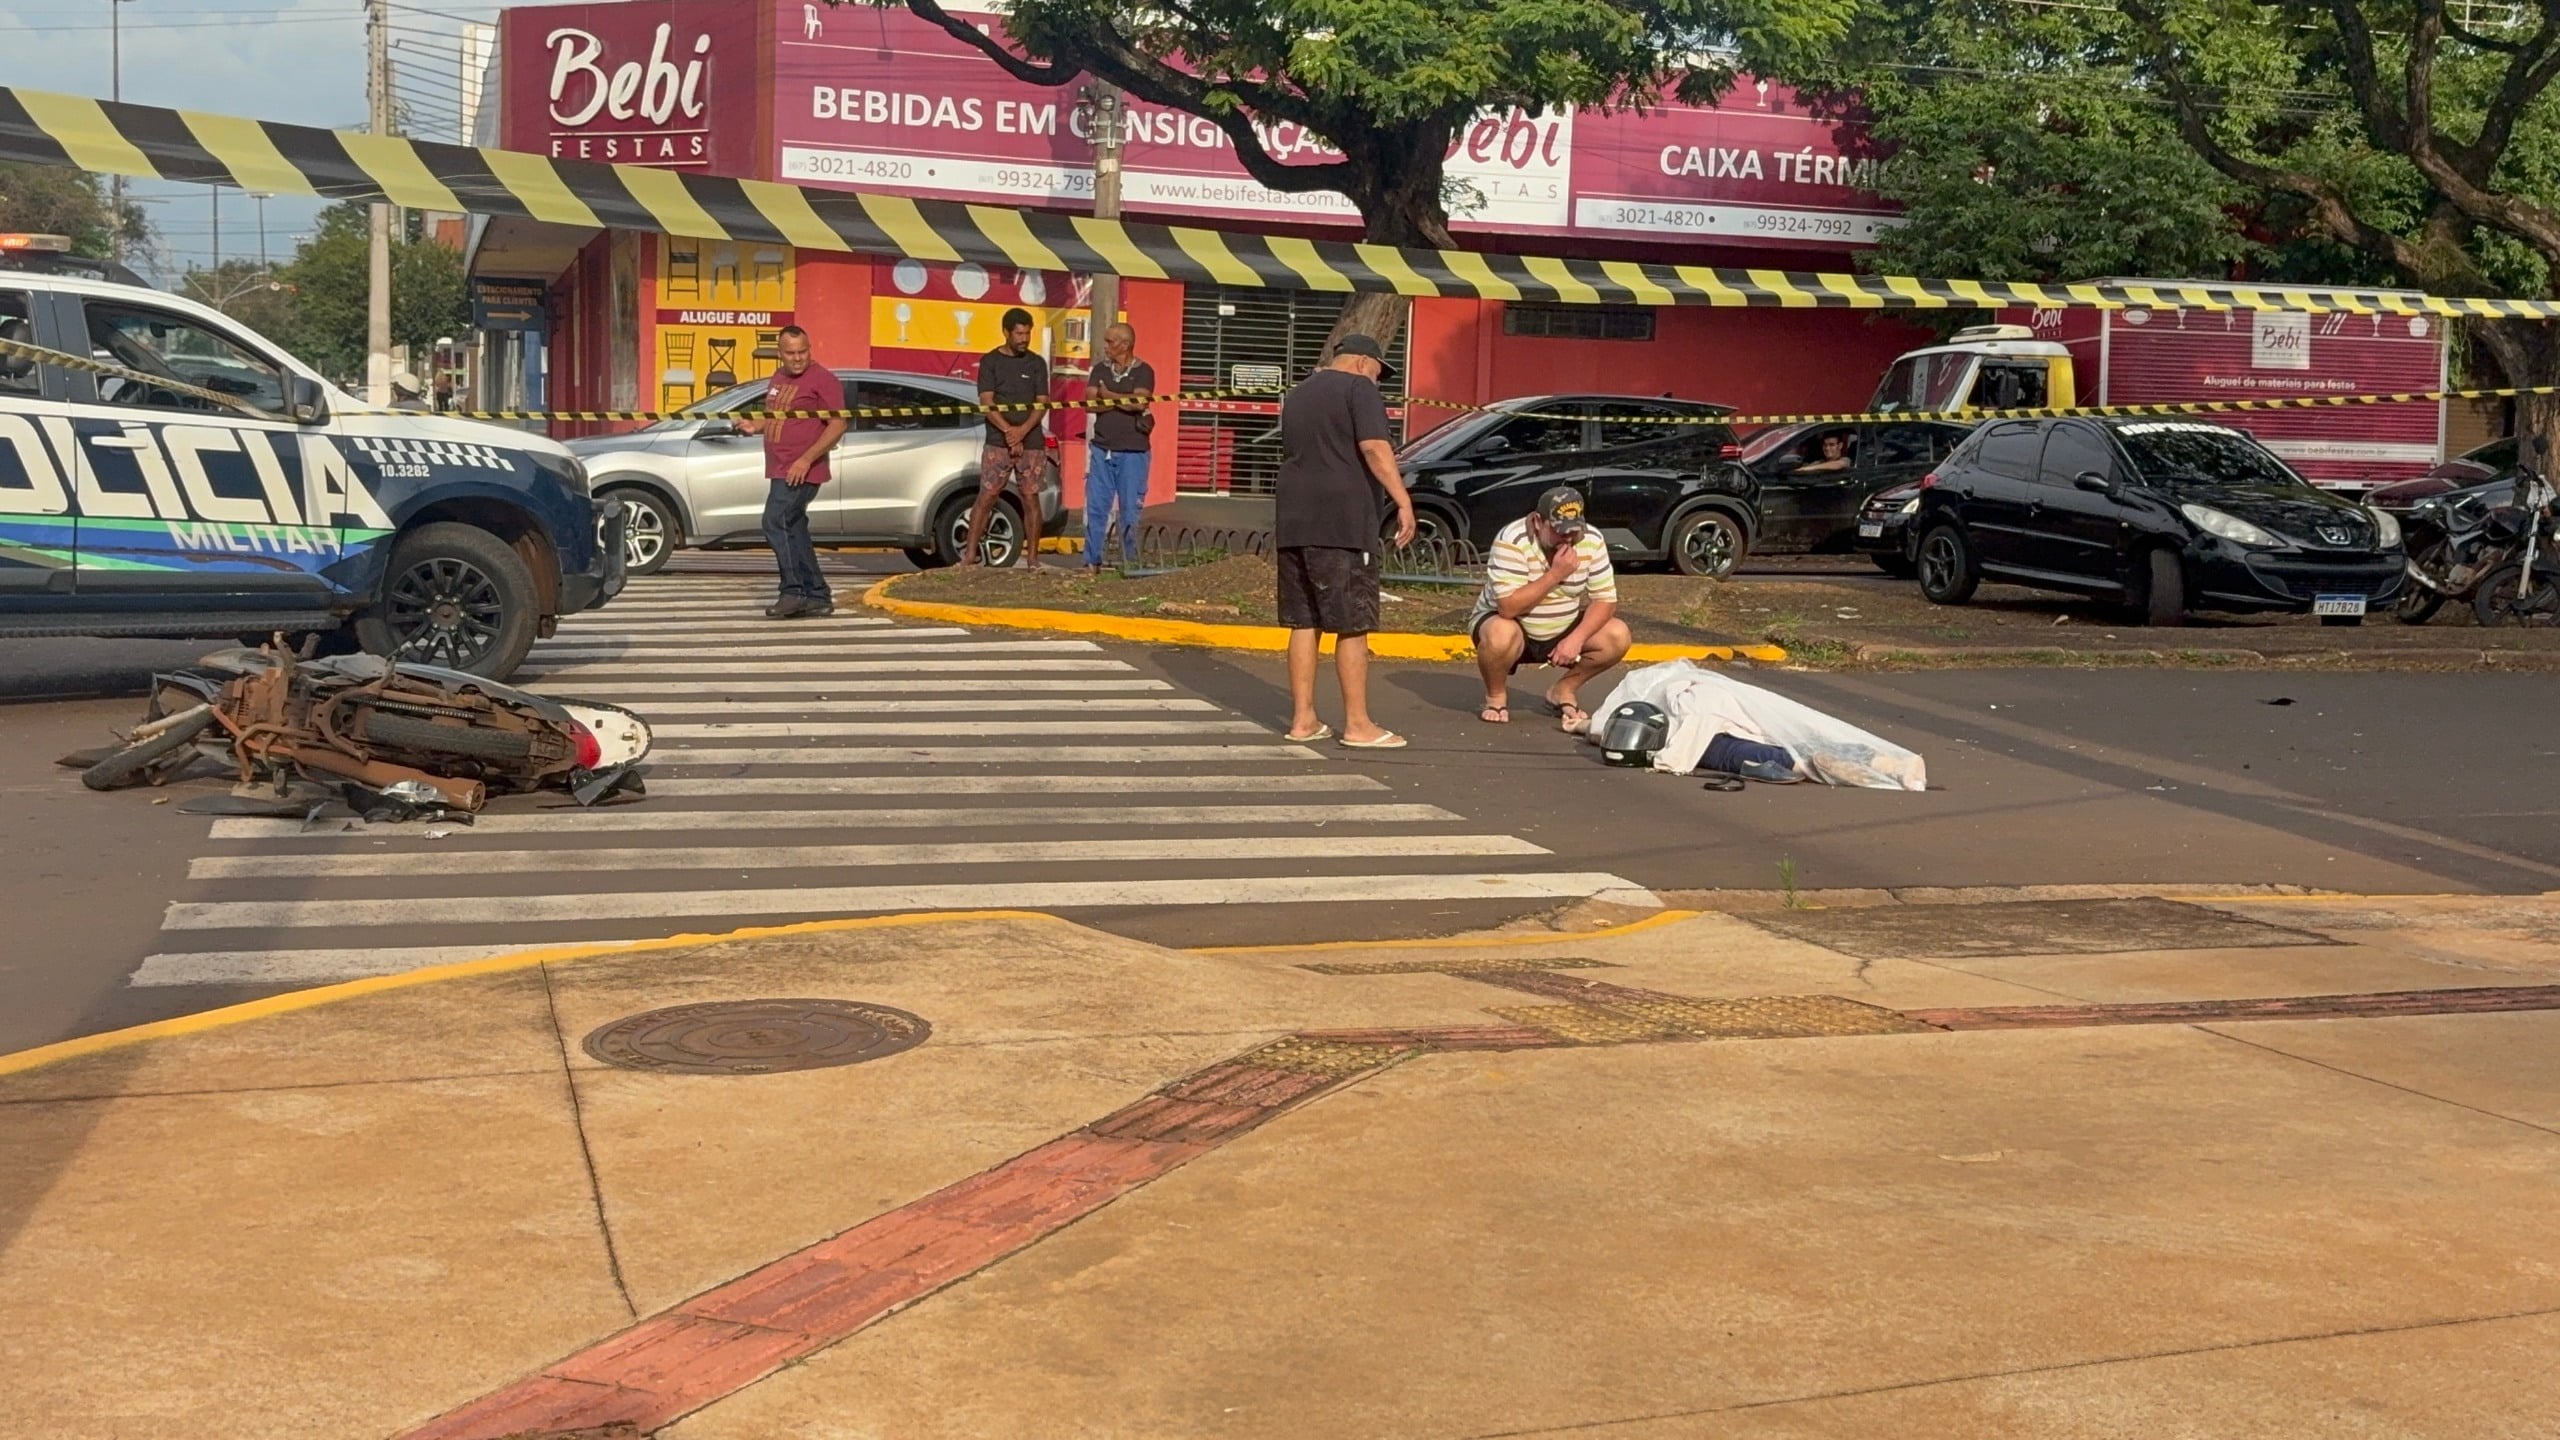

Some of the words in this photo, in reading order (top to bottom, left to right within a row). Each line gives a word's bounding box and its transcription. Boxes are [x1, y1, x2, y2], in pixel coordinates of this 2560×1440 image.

[546, 22, 711, 126] Bebi
[813, 86, 983, 131] BEBIDAS
[996, 101, 1056, 135] EM
[552, 136, 703, 159] FESTAS
[1443, 106, 1561, 169] ebi
[808, 156, 912, 179] 3021-4820
[997, 170, 1096, 192] 99324-799
[1660, 145, 1764, 181] CAIXA
[1150, 183, 1355, 208] www.bebifestas.com.b
[1616, 207, 1705, 227] 3021-4820
[1757, 214, 1852, 236] 99324-7992
[680, 311, 734, 324] ALUGUE
[738, 312, 772, 325] AQUI
[2261, 325, 2302, 349] Bebi
[2203, 376, 2241, 388] Aluguel
[2243, 378, 2256, 387] de
[2258, 379, 2302, 389] materiais
[2304, 381, 2325, 390] para
[2327, 380, 2356, 390] festas
[378, 464, 430, 477] 10.3282
[167, 521, 345, 556] MILITAR
